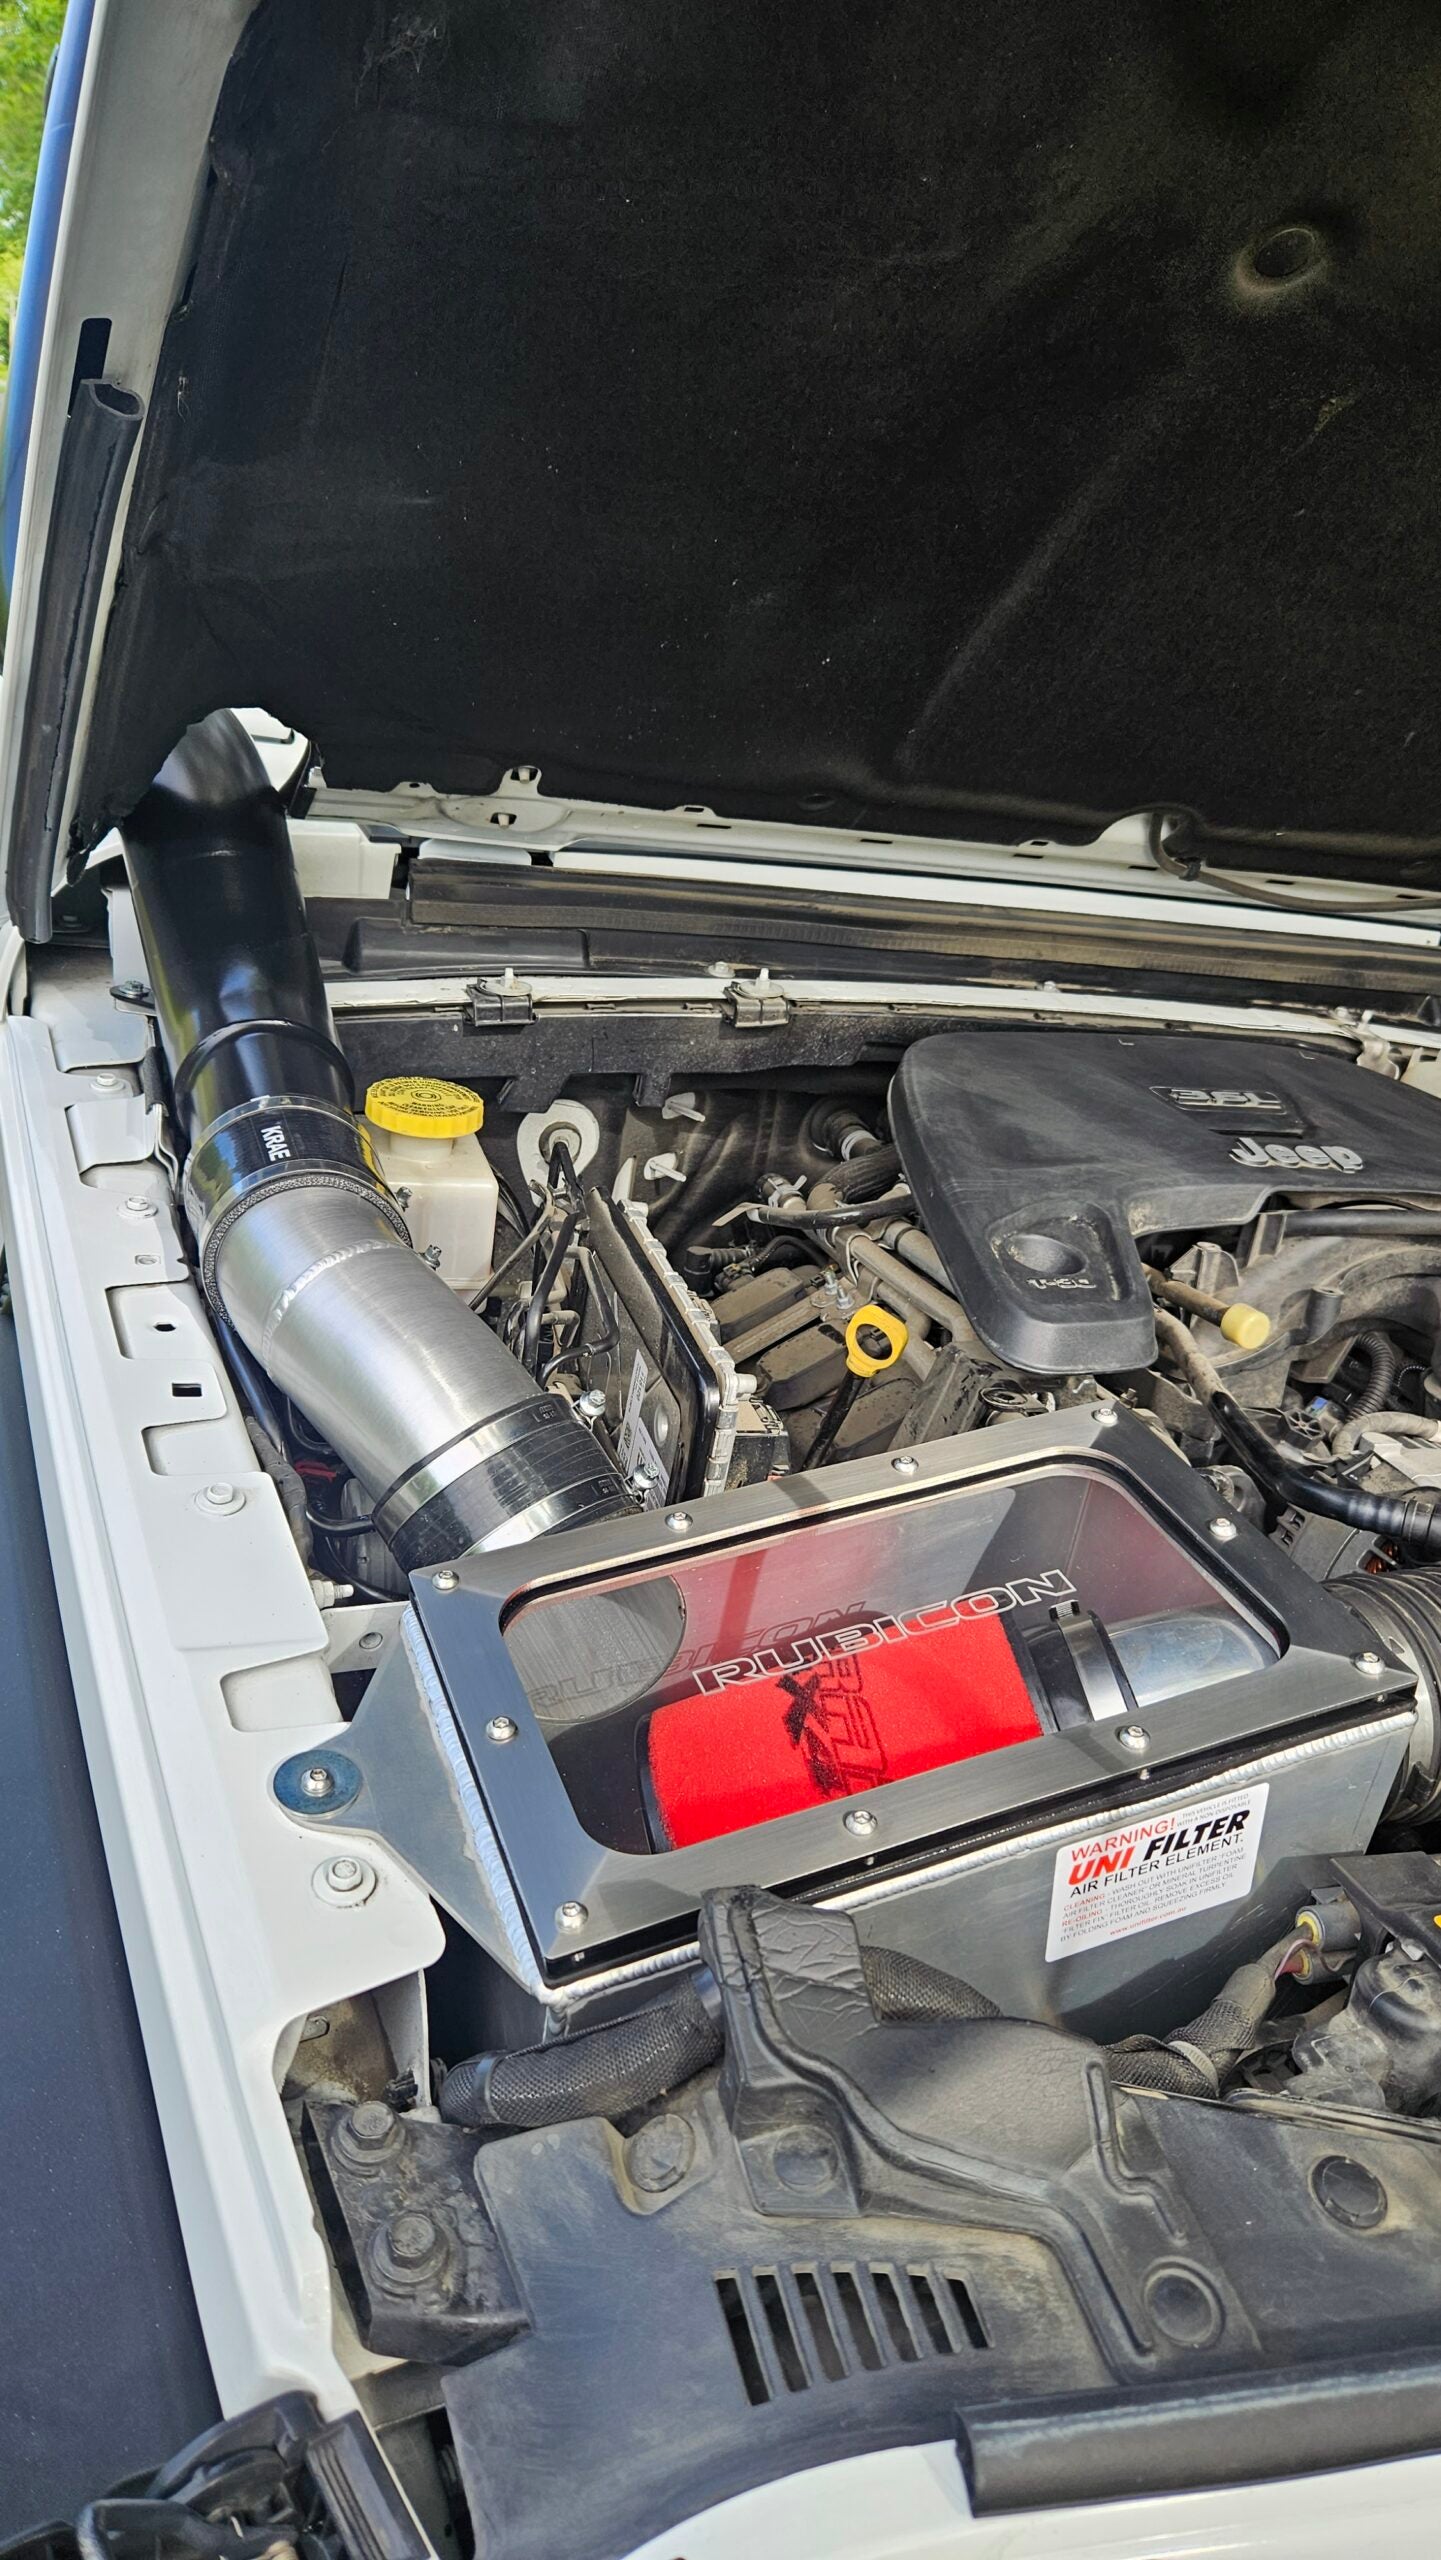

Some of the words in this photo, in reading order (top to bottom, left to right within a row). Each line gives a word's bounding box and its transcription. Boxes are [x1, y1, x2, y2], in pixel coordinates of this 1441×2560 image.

[261, 1125, 291, 1162] KRAE
[1229, 1137, 1364, 1174] Jeep
[693, 1569, 1078, 1695] RUBICON
[1176, 1816, 1193, 1828] WITH
[1195, 1801, 1220, 1815] VEHICLE
[1227, 1792, 1249, 1805] FITTED
[1067, 1844, 1135, 1886] UNI
[1143, 1807, 1251, 1861] FILTER
[1069, 1878, 1099, 1898] AIR
[1104, 1858, 1160, 1887] FILTER
[1165, 1830, 1245, 1867] ELEMENT.
[1070, 1816, 1176, 1863] WARNING!
[1061, 1907, 1103, 1927] RE-OILING
[1109, 1886, 1165, 1911] THOROUGHLY
[1165, 1879, 1188, 1892] SOAK
[1188, 1876, 1197, 1884] IN
[1198, 1862, 1238, 1881] UNIFILTER
[1062, 1908, 1077, 1919] AIR
[1077, 1899, 1105, 1914] FILTER
[1148, 1880, 1161, 1891] OR
[1161, 1869, 1196, 1886] MINERAL
[1197, 1852, 1247, 1874] TURPENTINE
[1063, 1892, 1105, 1912] CLEANING
[1111, 1881, 1136, 1895] WASH
[1136, 1875, 1155, 1887] OUT
[1155, 1868, 1177, 1881] WITH
[1177, 1854, 1218, 1874] UNIFILTER
[1108, 1903, 1136, 1918] FILTER
[1154, 1885, 1189, 1903] REMOVE
[1189, 1875, 1221, 1891] EXCESS
[1059, 1933, 1070, 1942] BY
[1072, 1920, 1108, 1938] FOLDING
[1109, 1912, 1133, 1926] FOAM
[1132, 1905, 1151, 1918] AND
[1152, 1890, 1198, 1911] SQUEEZING
[1109, 1905, 1186, 1937] www.unifilter.com.au
